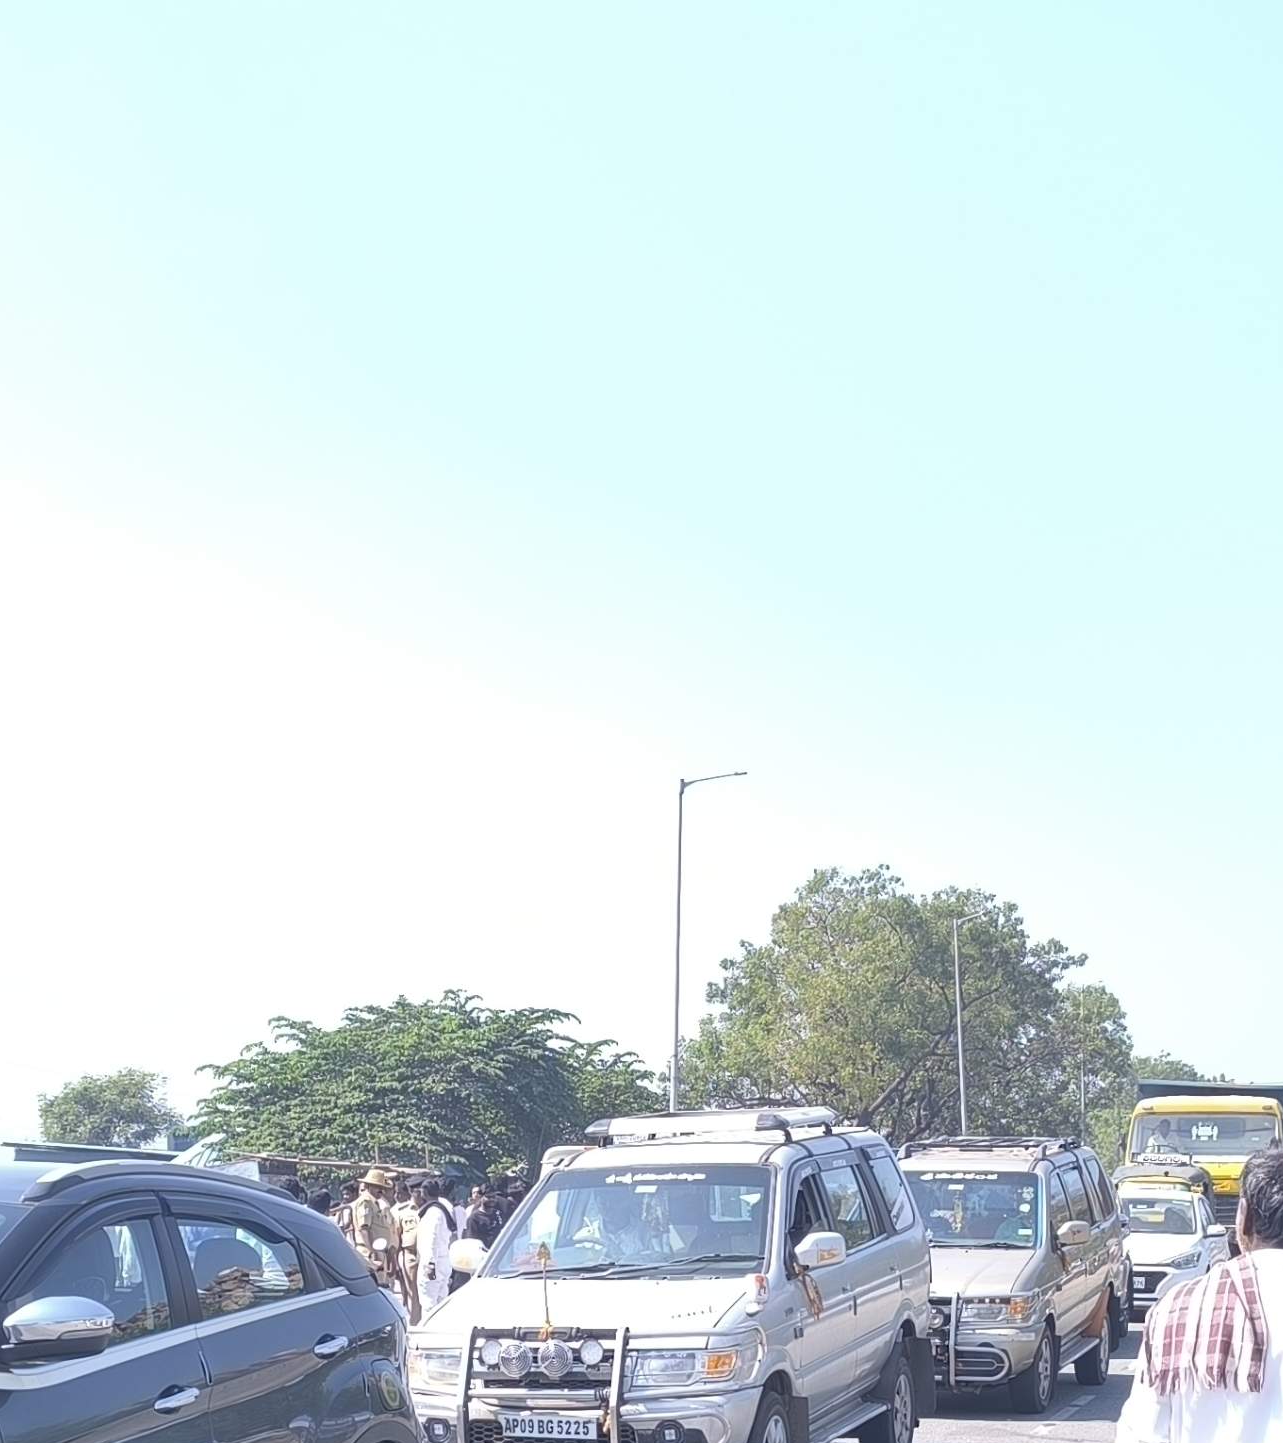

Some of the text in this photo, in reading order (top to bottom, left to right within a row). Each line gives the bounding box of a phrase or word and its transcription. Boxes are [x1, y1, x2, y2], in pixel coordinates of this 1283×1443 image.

[504, 1417, 590, 1436] AP09 BG 5225
